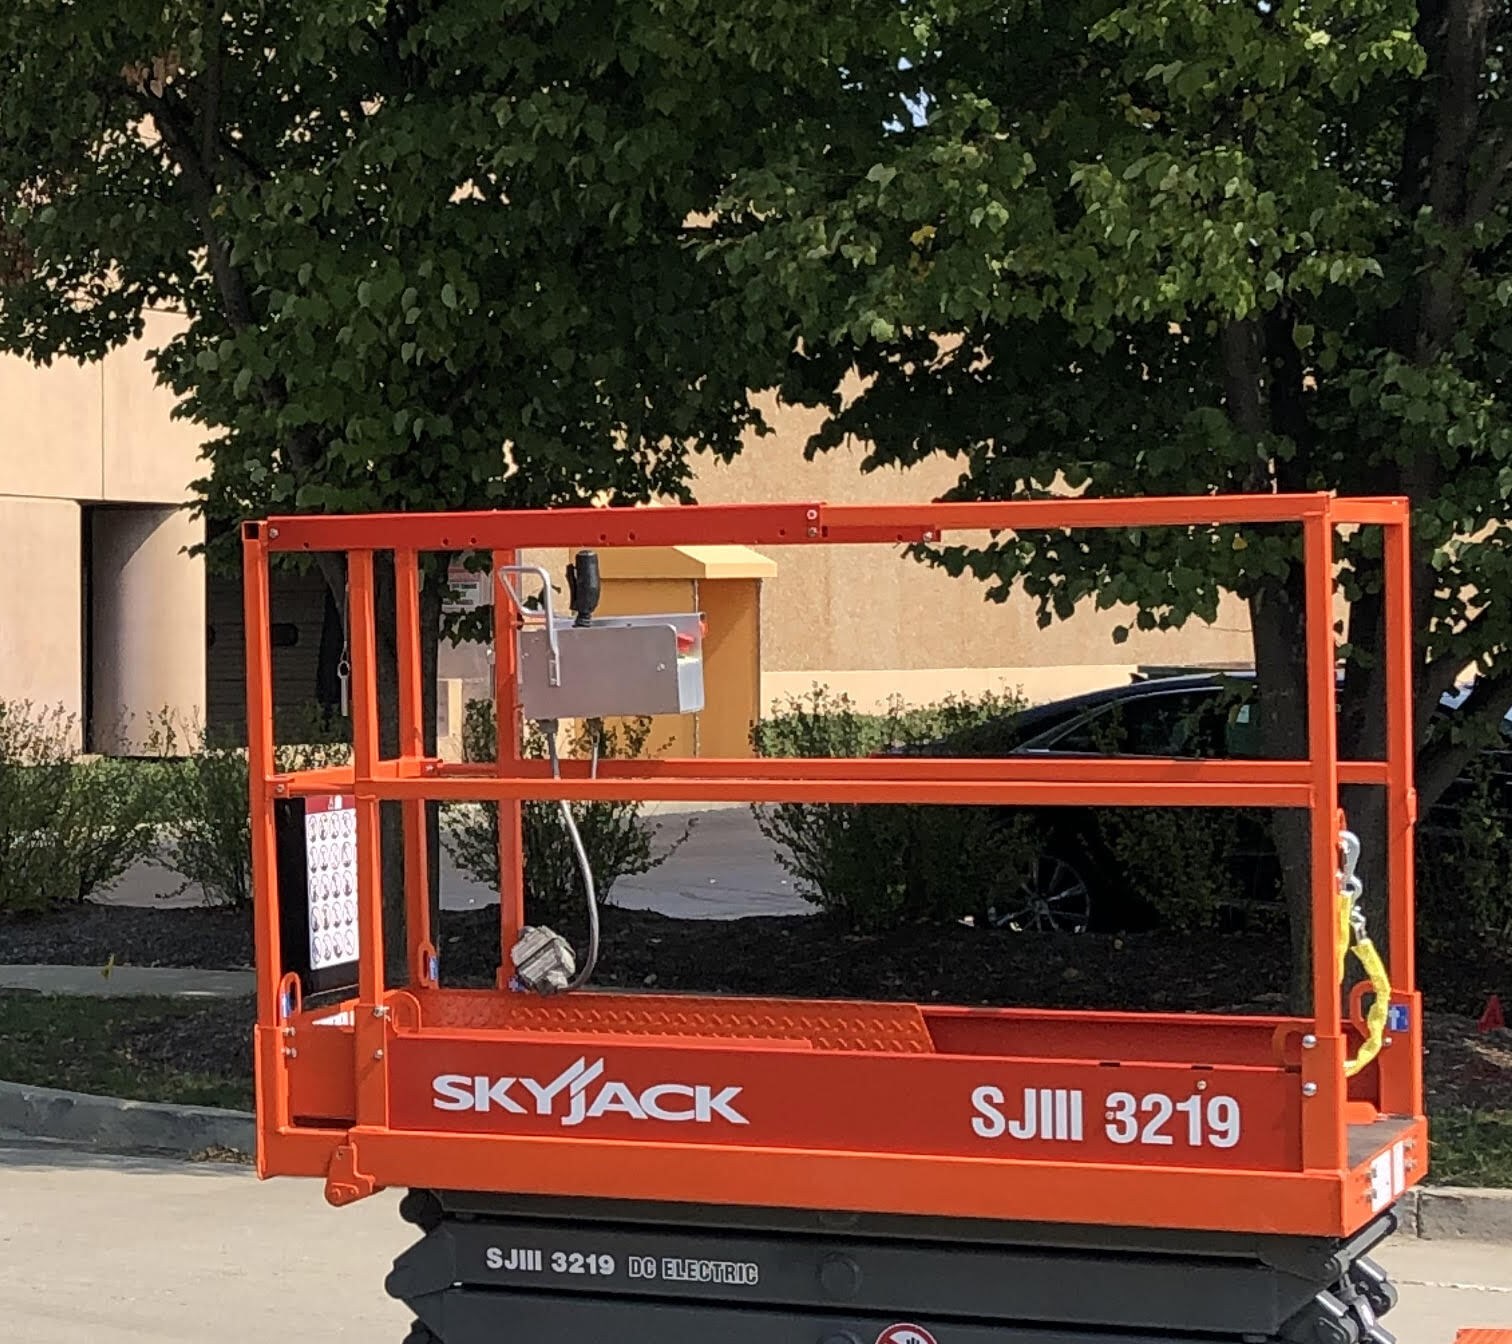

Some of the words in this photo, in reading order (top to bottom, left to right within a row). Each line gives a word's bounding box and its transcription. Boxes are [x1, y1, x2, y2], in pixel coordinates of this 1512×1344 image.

[432, 1056, 750, 1125] SKYJACK
[971, 1085, 1083, 1142] SJIII
[1105, 1091, 1240, 1149] 3219
[486, 1247, 543, 1271] SJIII
[551, 1251, 615, 1275] 3219
[628, 1256, 657, 1279] DC
[662, 1259, 759, 1286] ELECTRIC
